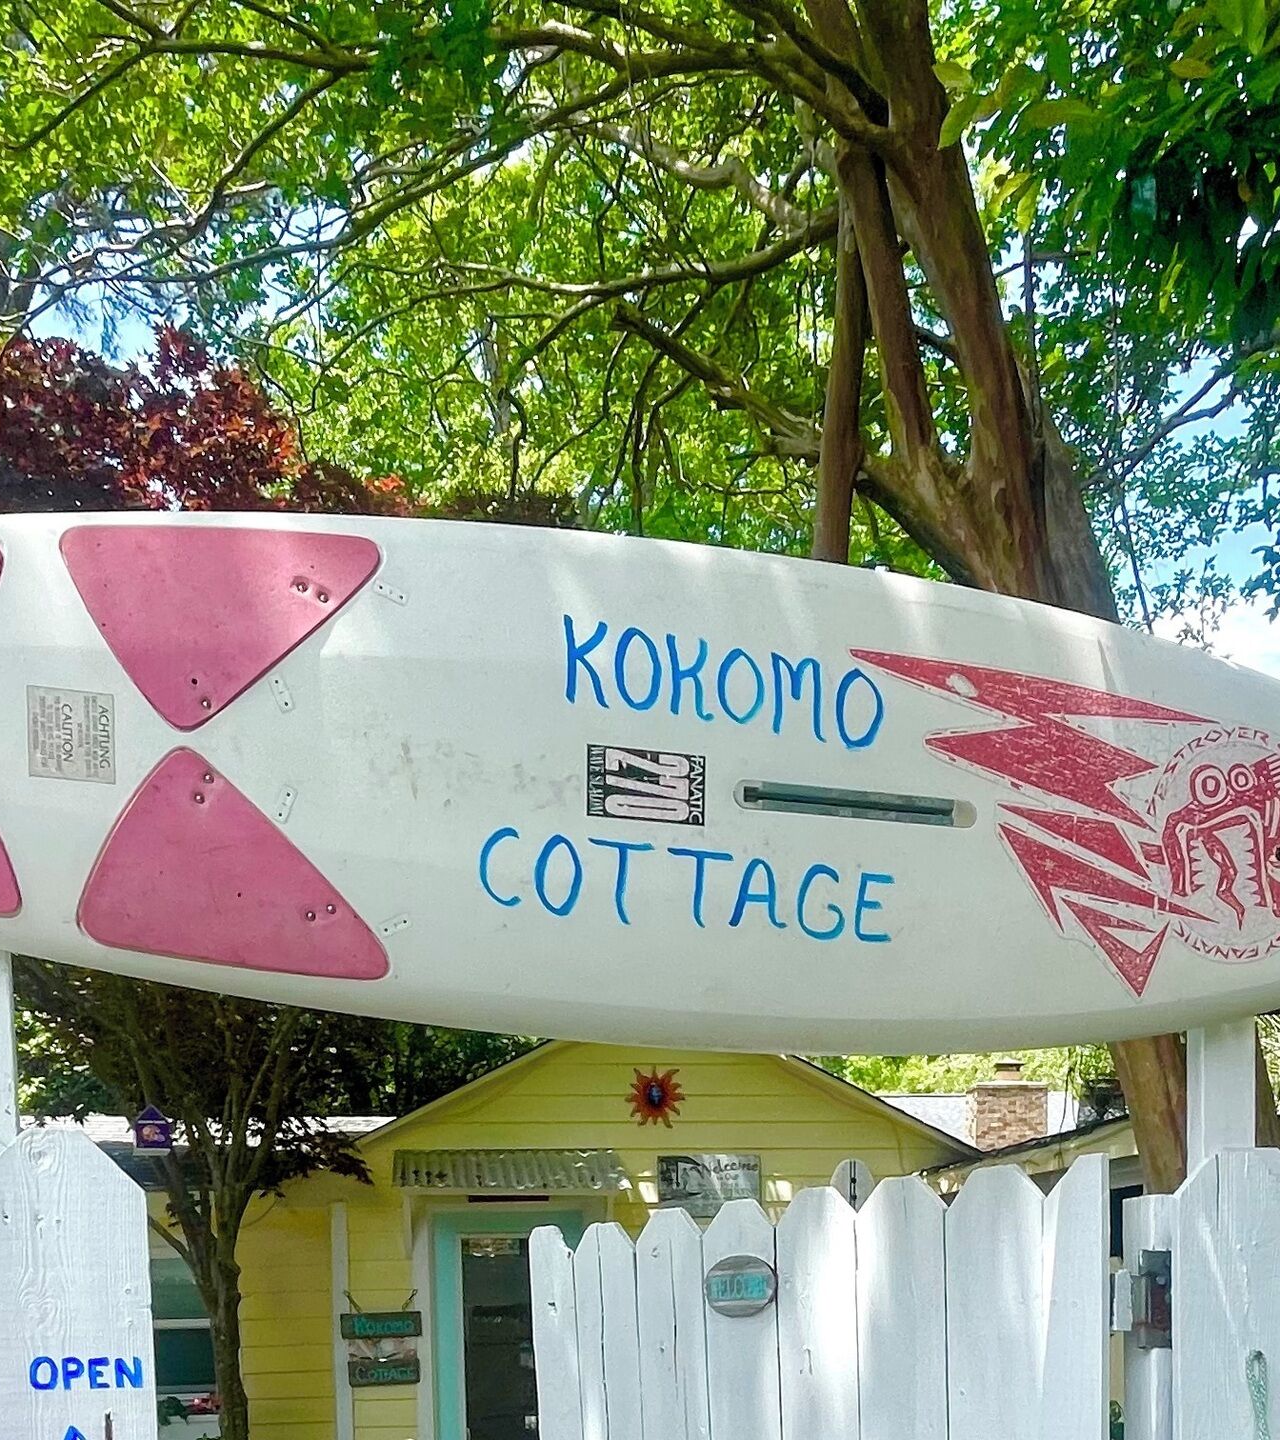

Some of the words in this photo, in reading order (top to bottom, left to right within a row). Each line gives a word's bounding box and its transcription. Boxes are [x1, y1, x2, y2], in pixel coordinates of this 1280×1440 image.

[562, 613, 886, 750] KOKOMO
[61, 703, 73, 762] CAUTION
[99, 705, 111, 769] ACHTUNG
[604, 748, 690, 821] 270
[689, 755, 704, 824] FANATIC
[478, 826, 896, 944] COTTAGE
[1172, 920, 1260, 960] FANATIC
[29, 1356, 144, 1390] OPEN
